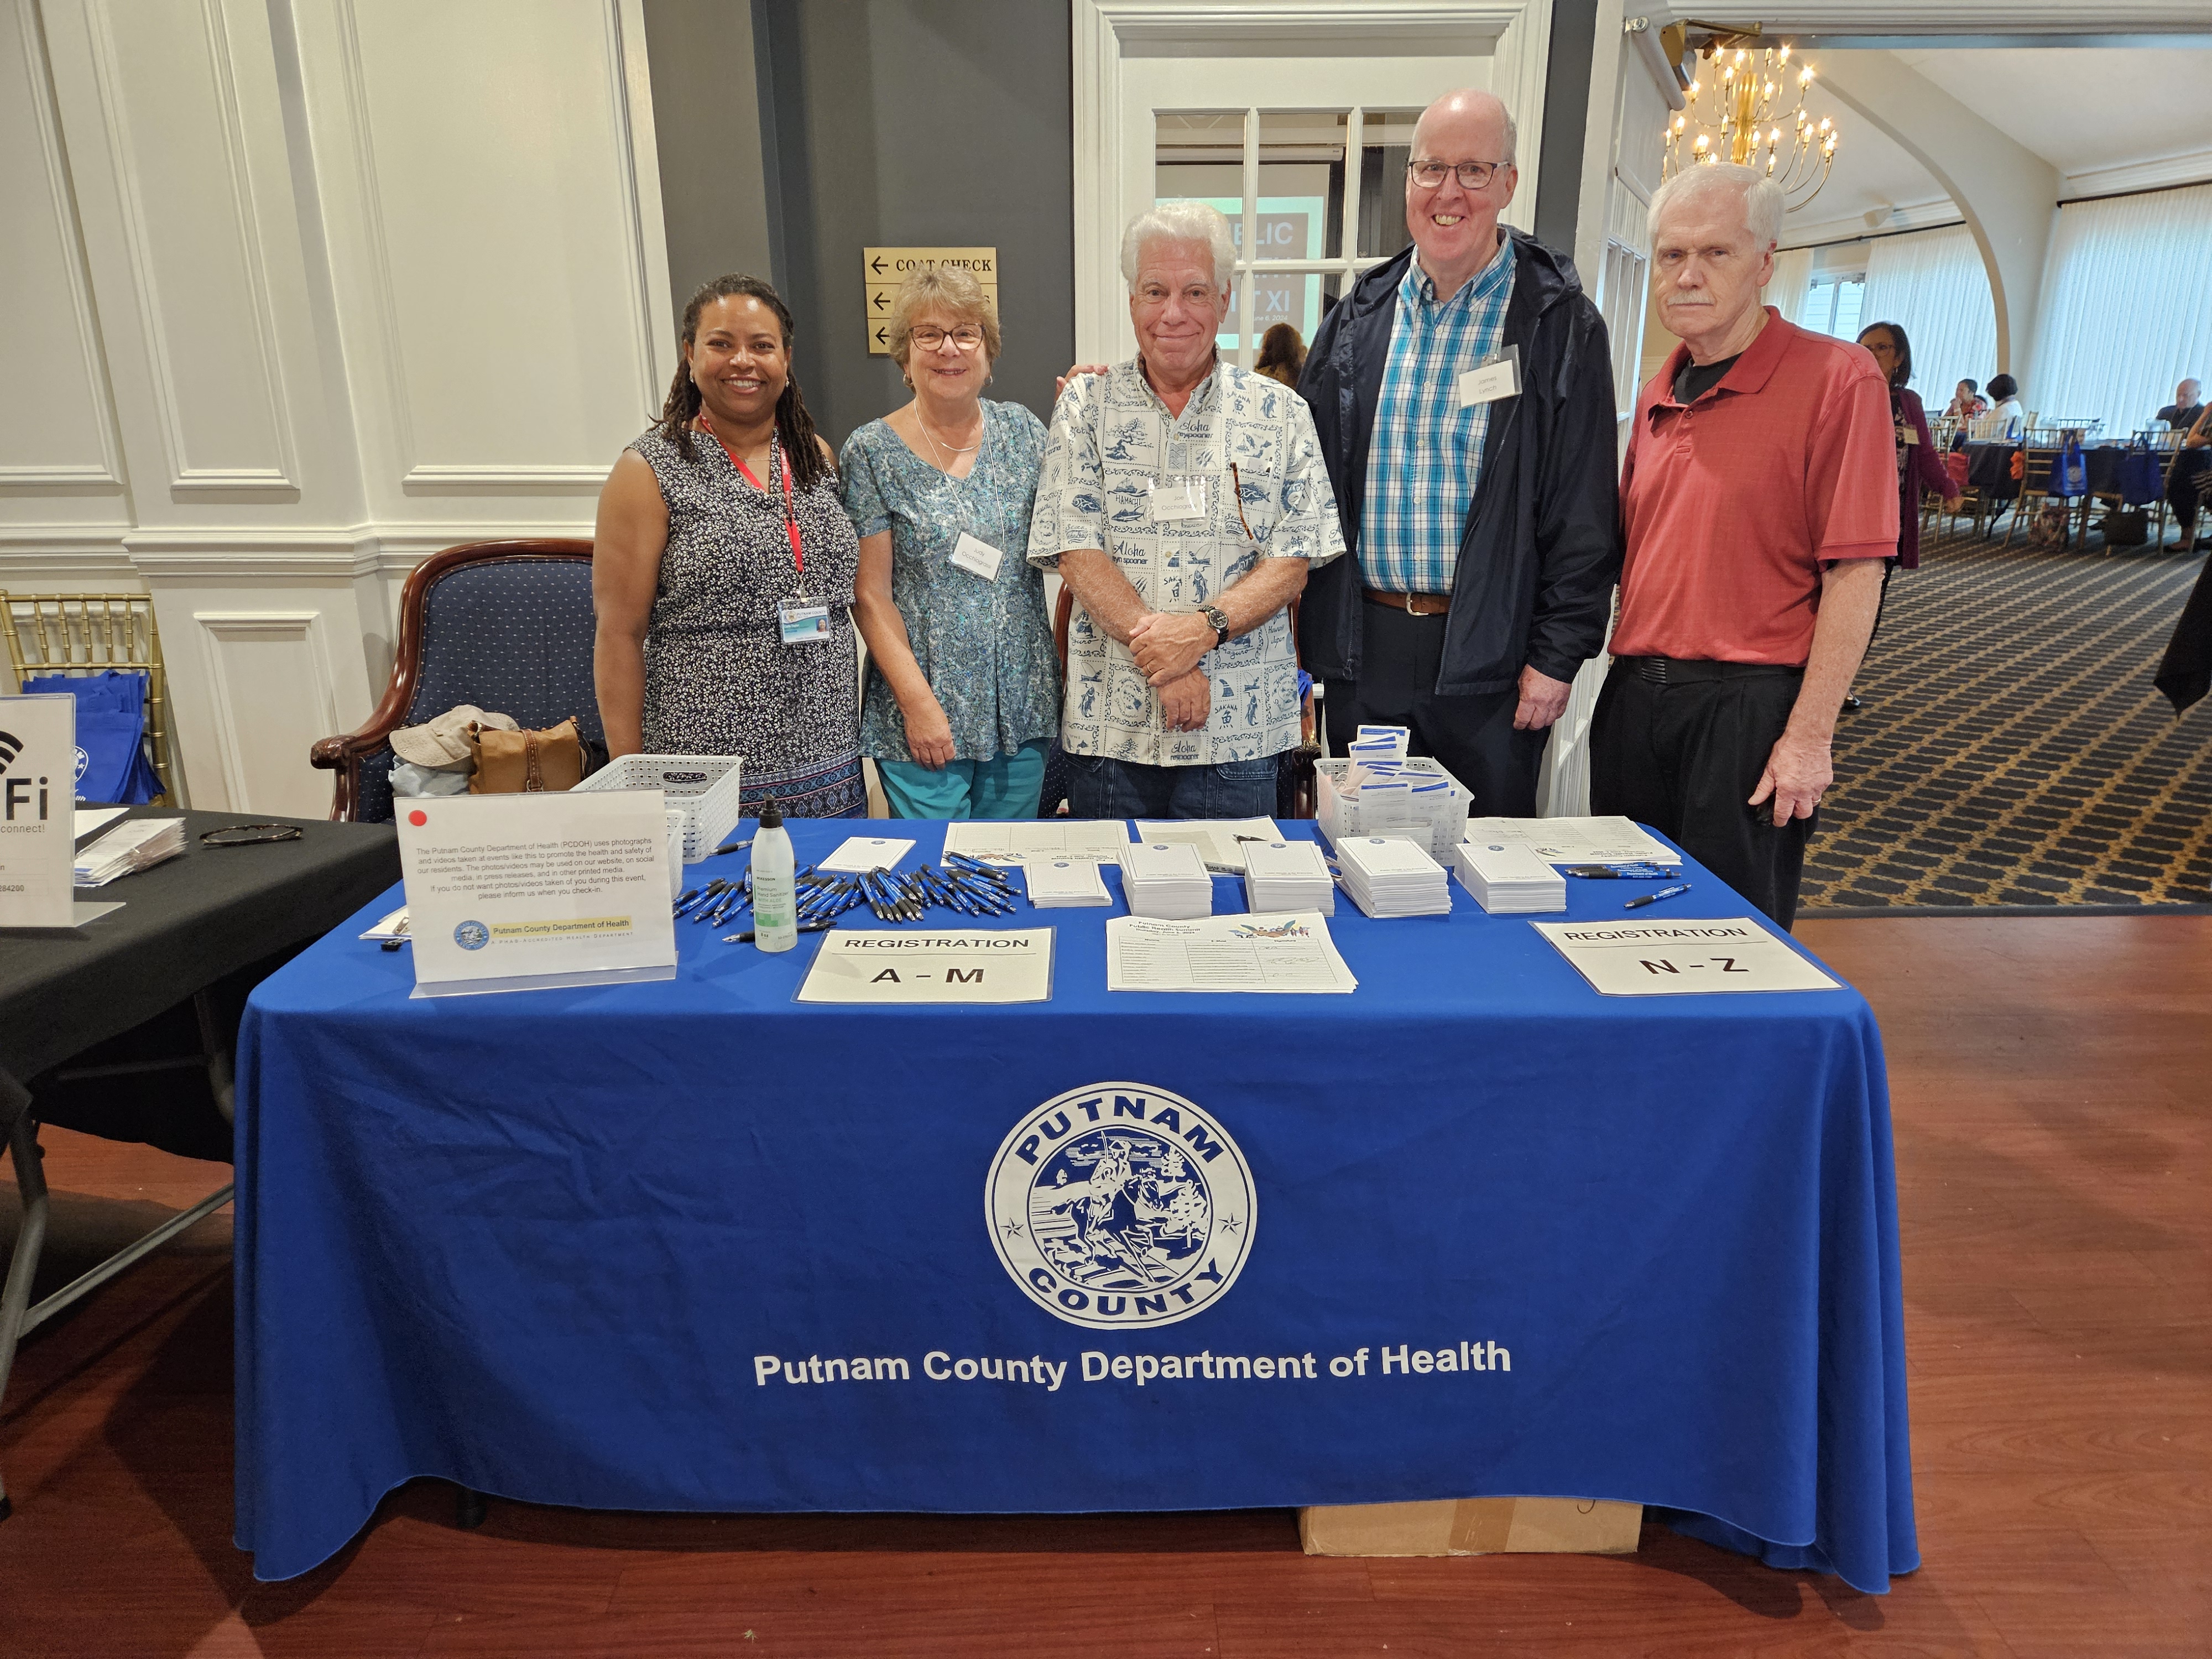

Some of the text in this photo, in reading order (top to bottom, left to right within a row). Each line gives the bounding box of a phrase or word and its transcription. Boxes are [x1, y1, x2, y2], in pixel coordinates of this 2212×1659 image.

[1228, 222, 1293, 244] BIC
[896, 259, 992, 272] COAT CHECK
[1478, 376, 1497, 385] James
[1479, 385, 1497, 394] Lynch
[1115, 494, 1141, 507] HAMACHI
[1113, 540, 1146, 557] Aloha
[962, 551, 992, 569] Occhiograssi
[1215, 703, 1238, 714] SAKANA
[1, 824, 45, 833] connect!
[561, 840, 592, 849] (PCDOH)
[612, 837, 652, 847] photographs
[547, 851, 574, 859] promote
[482, 862, 528, 872] photos/videos
[578, 867, 601, 875] printed
[495, 880, 542, 890] photos/videos
[558, 888, 570, 896] you
[524, 925, 550, 933] County
[553, 922, 595, 931] Department
[1563, 928, 1749, 940] REGISTRATION
[844, 939, 1029, 948] REGISTRATION
[1639, 959, 1681, 974] N
[1709, 958, 1750, 972] Z
[870, 968, 902, 983] A
[946, 968, 984, 983] M
[1015, 1095, 1225, 1167] PUTNAM
[1026, 1257, 1225, 1316] COUNTY
[754, 1340, 1511, 1391] Putnam County Department of Health
